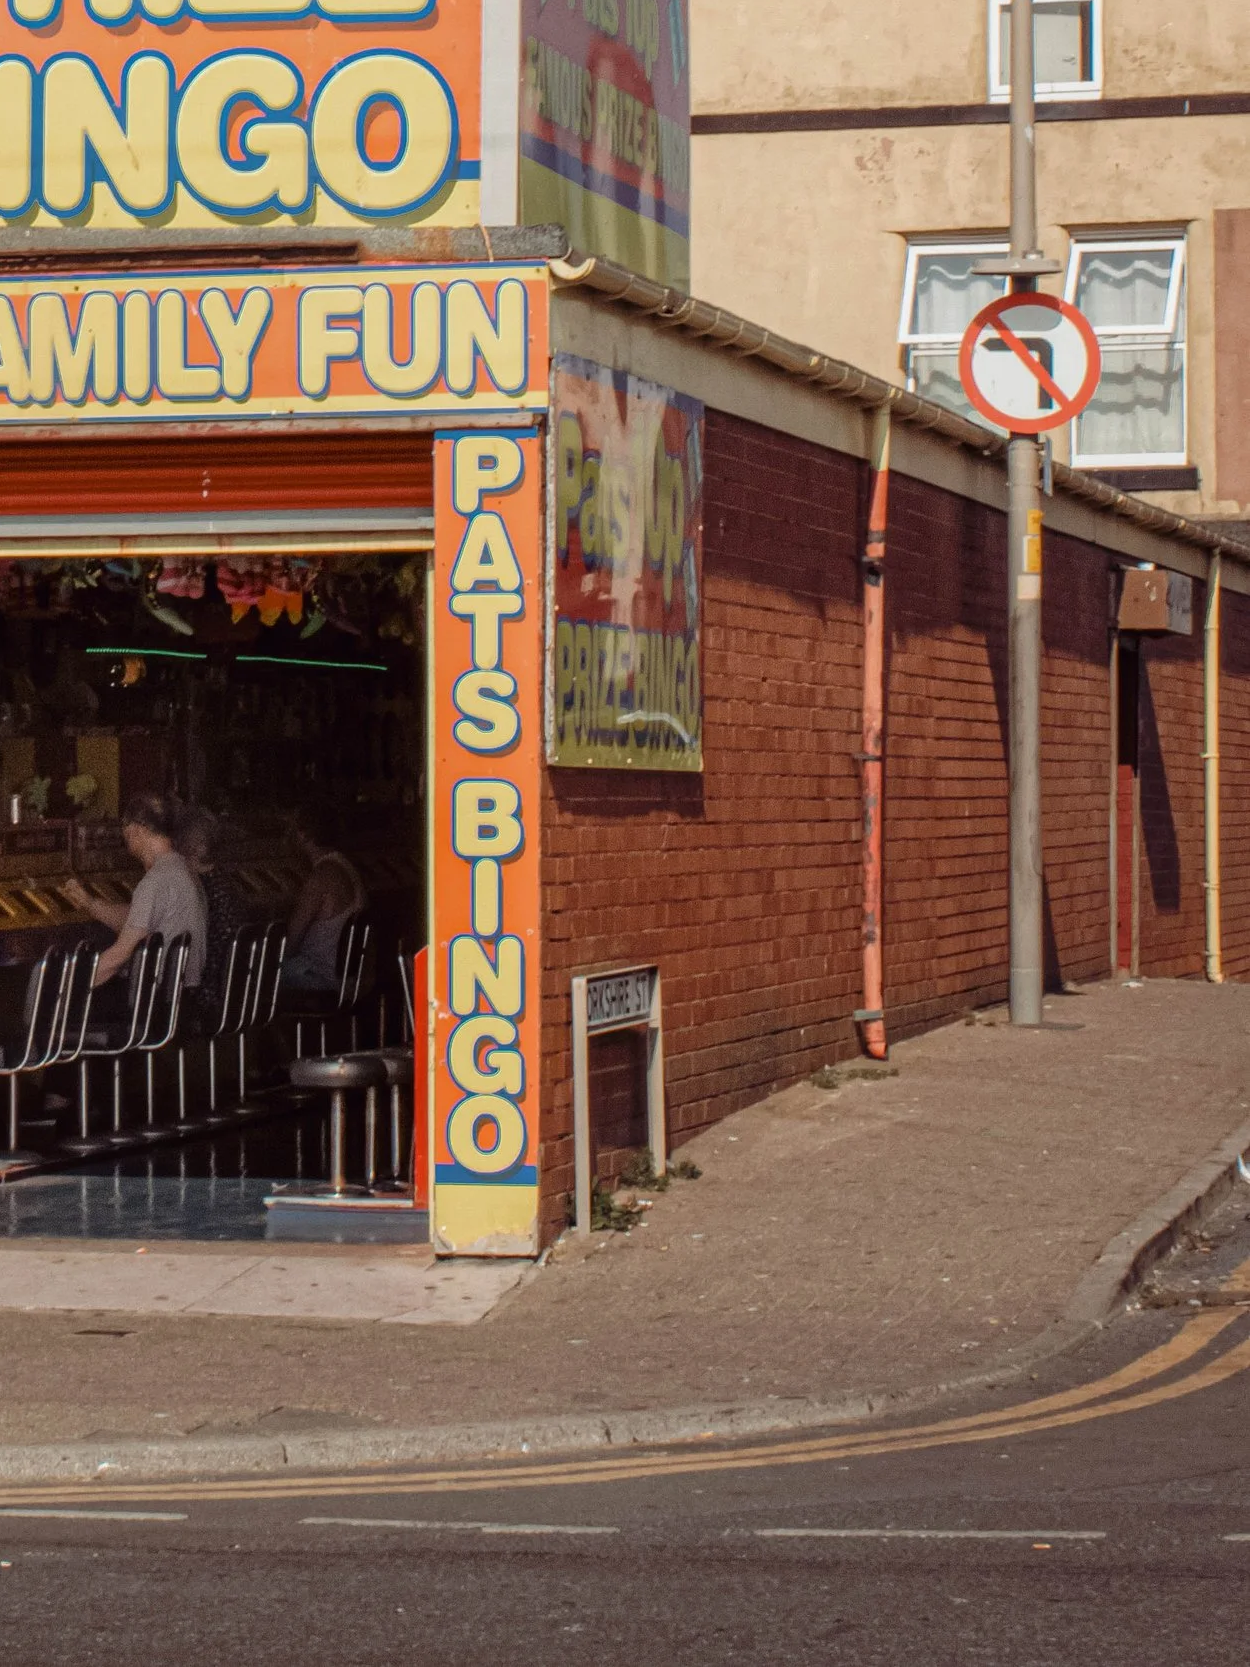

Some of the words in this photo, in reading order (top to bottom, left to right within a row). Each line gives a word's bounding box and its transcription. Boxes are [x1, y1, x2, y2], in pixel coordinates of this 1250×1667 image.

[595, 76, 645, 168] PRIZE
[298, 276, 531, 401] FUN
[555, 411, 631, 576] Pats
[449, 435, 525, 754] PATS
[555, 617, 633, 745] PRIZE
[633, 628, 700, 752] BINGO
[446, 778, 528, 1177] BINGO
